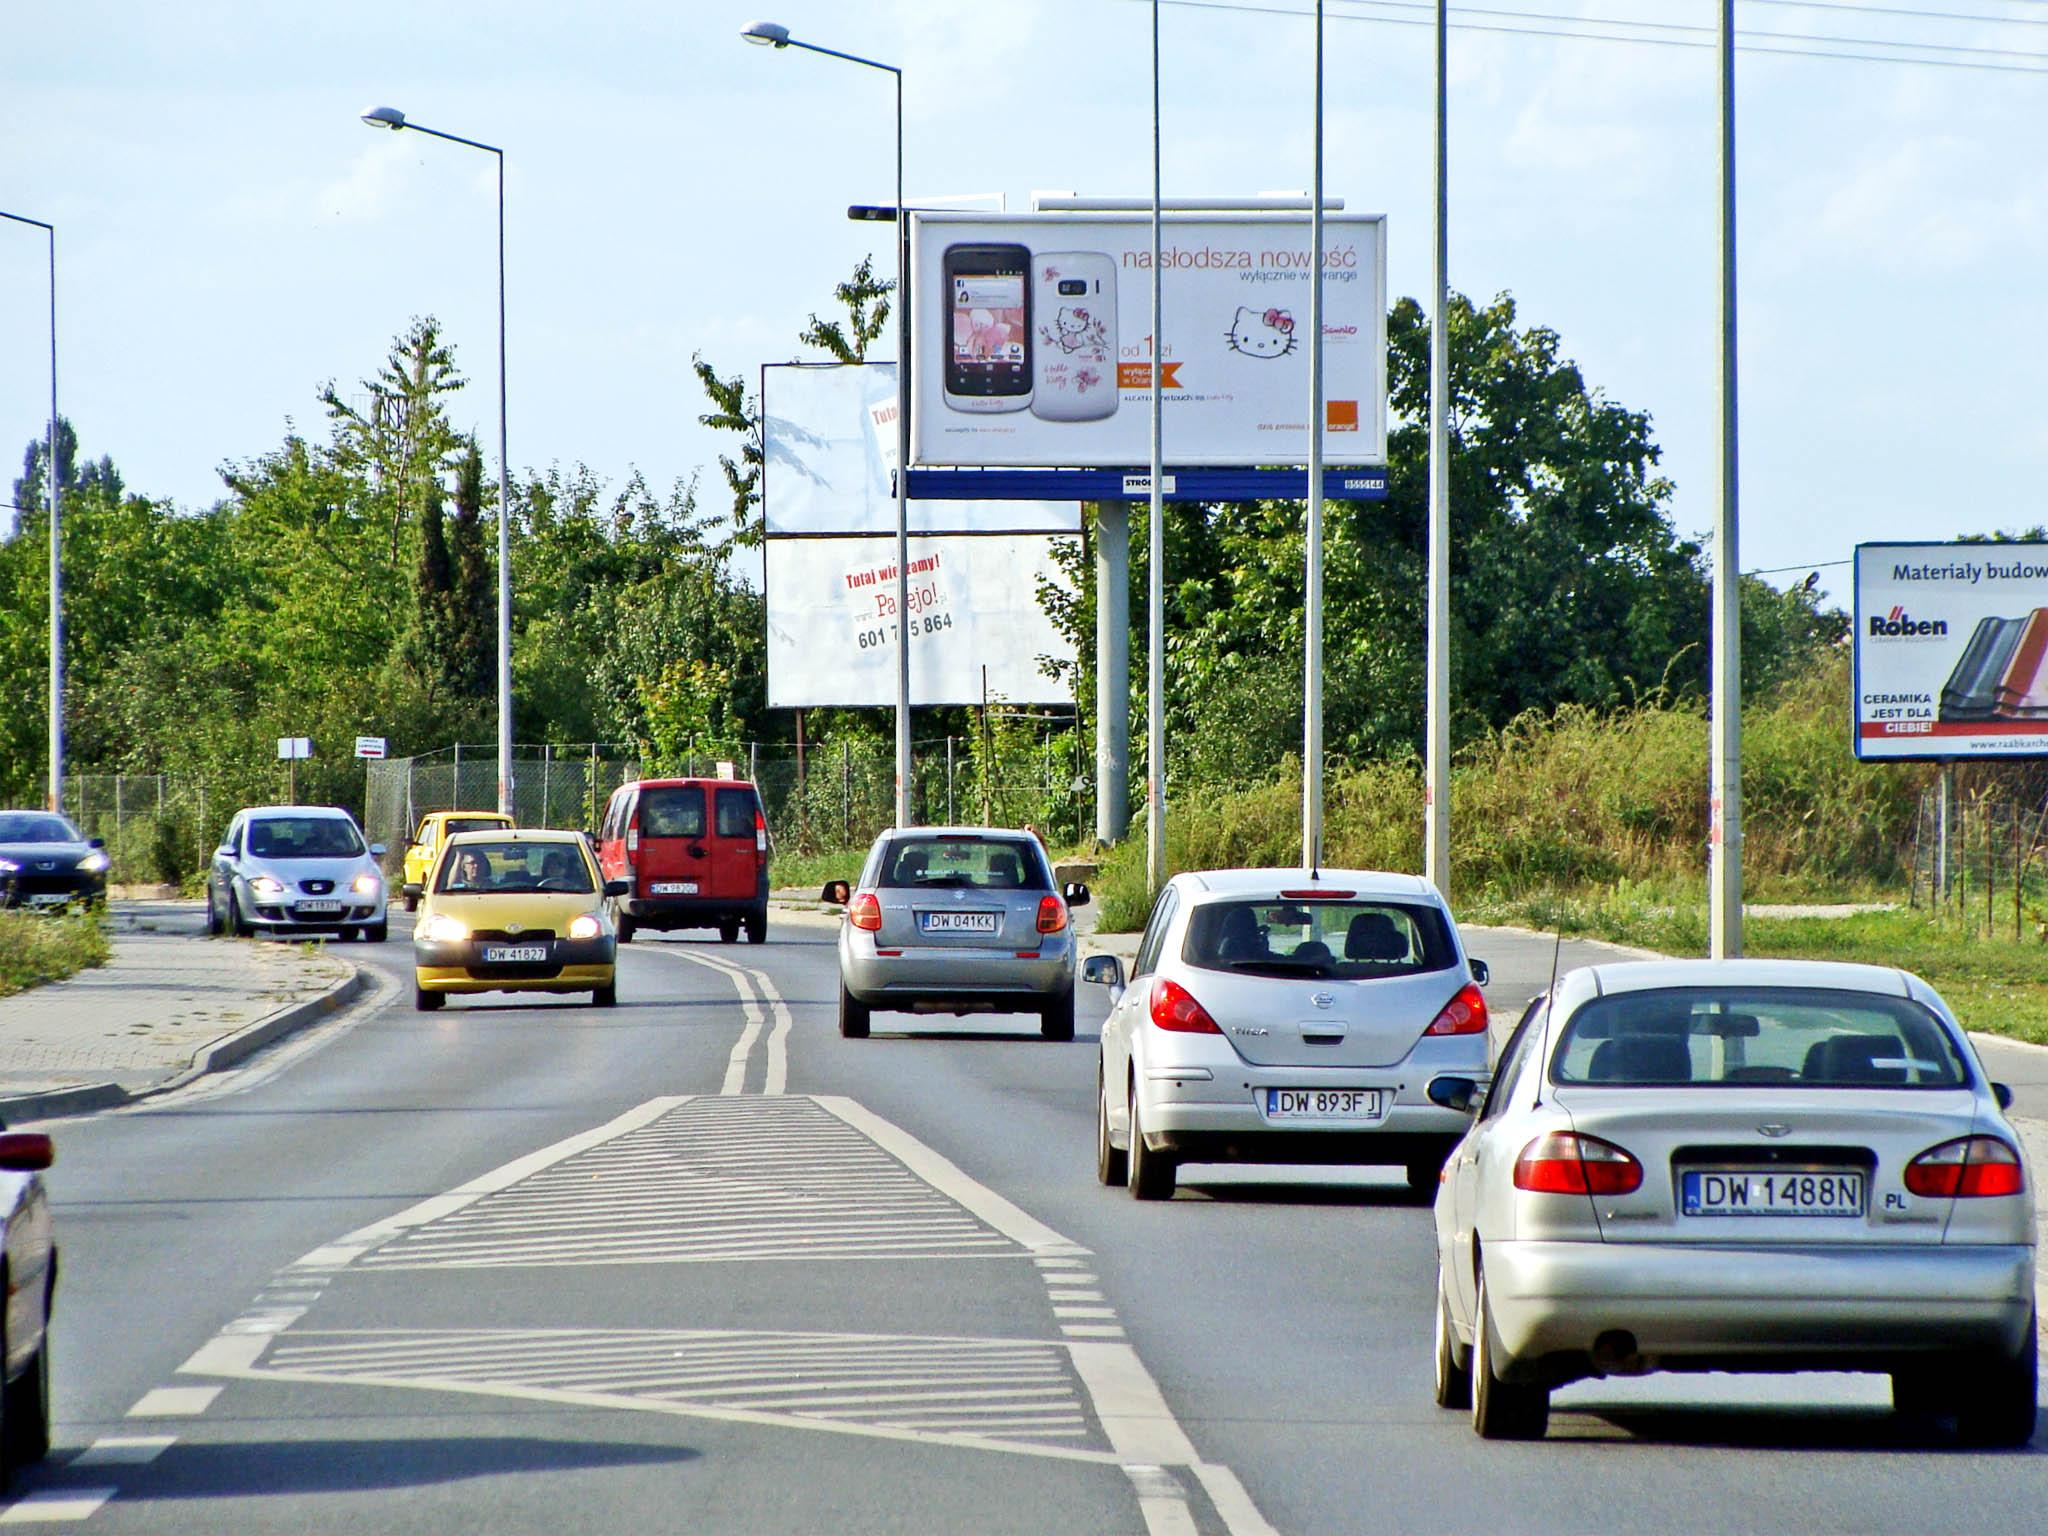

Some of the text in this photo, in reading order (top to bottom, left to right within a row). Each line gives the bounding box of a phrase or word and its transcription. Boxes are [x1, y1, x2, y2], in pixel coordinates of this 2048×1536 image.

[1123, 246, 1251, 269] nasłodsza
[1240, 270, 1357, 283] wyłącznie w range
[1121, 344, 1140, 357] od
[846, 569, 876, 589] Tutaj
[1893, 563, 1982, 584] Materiały
[858, 612, 952, 648] 601 75 864
[1864, 693, 1931, 704] CERAMIKA
[1871, 708, 1931, 718] JEST DLA
[1885, 722, 1932, 733] CIEBIE!
[931, 915, 993, 927] DW 041KK
[490, 949, 544, 960] DW 41827
[1281, 1093, 1309, 1112] DW
[1705, 1177, 1858, 1206] DW 1488N
[1885, 1193, 1906, 1208] PL
